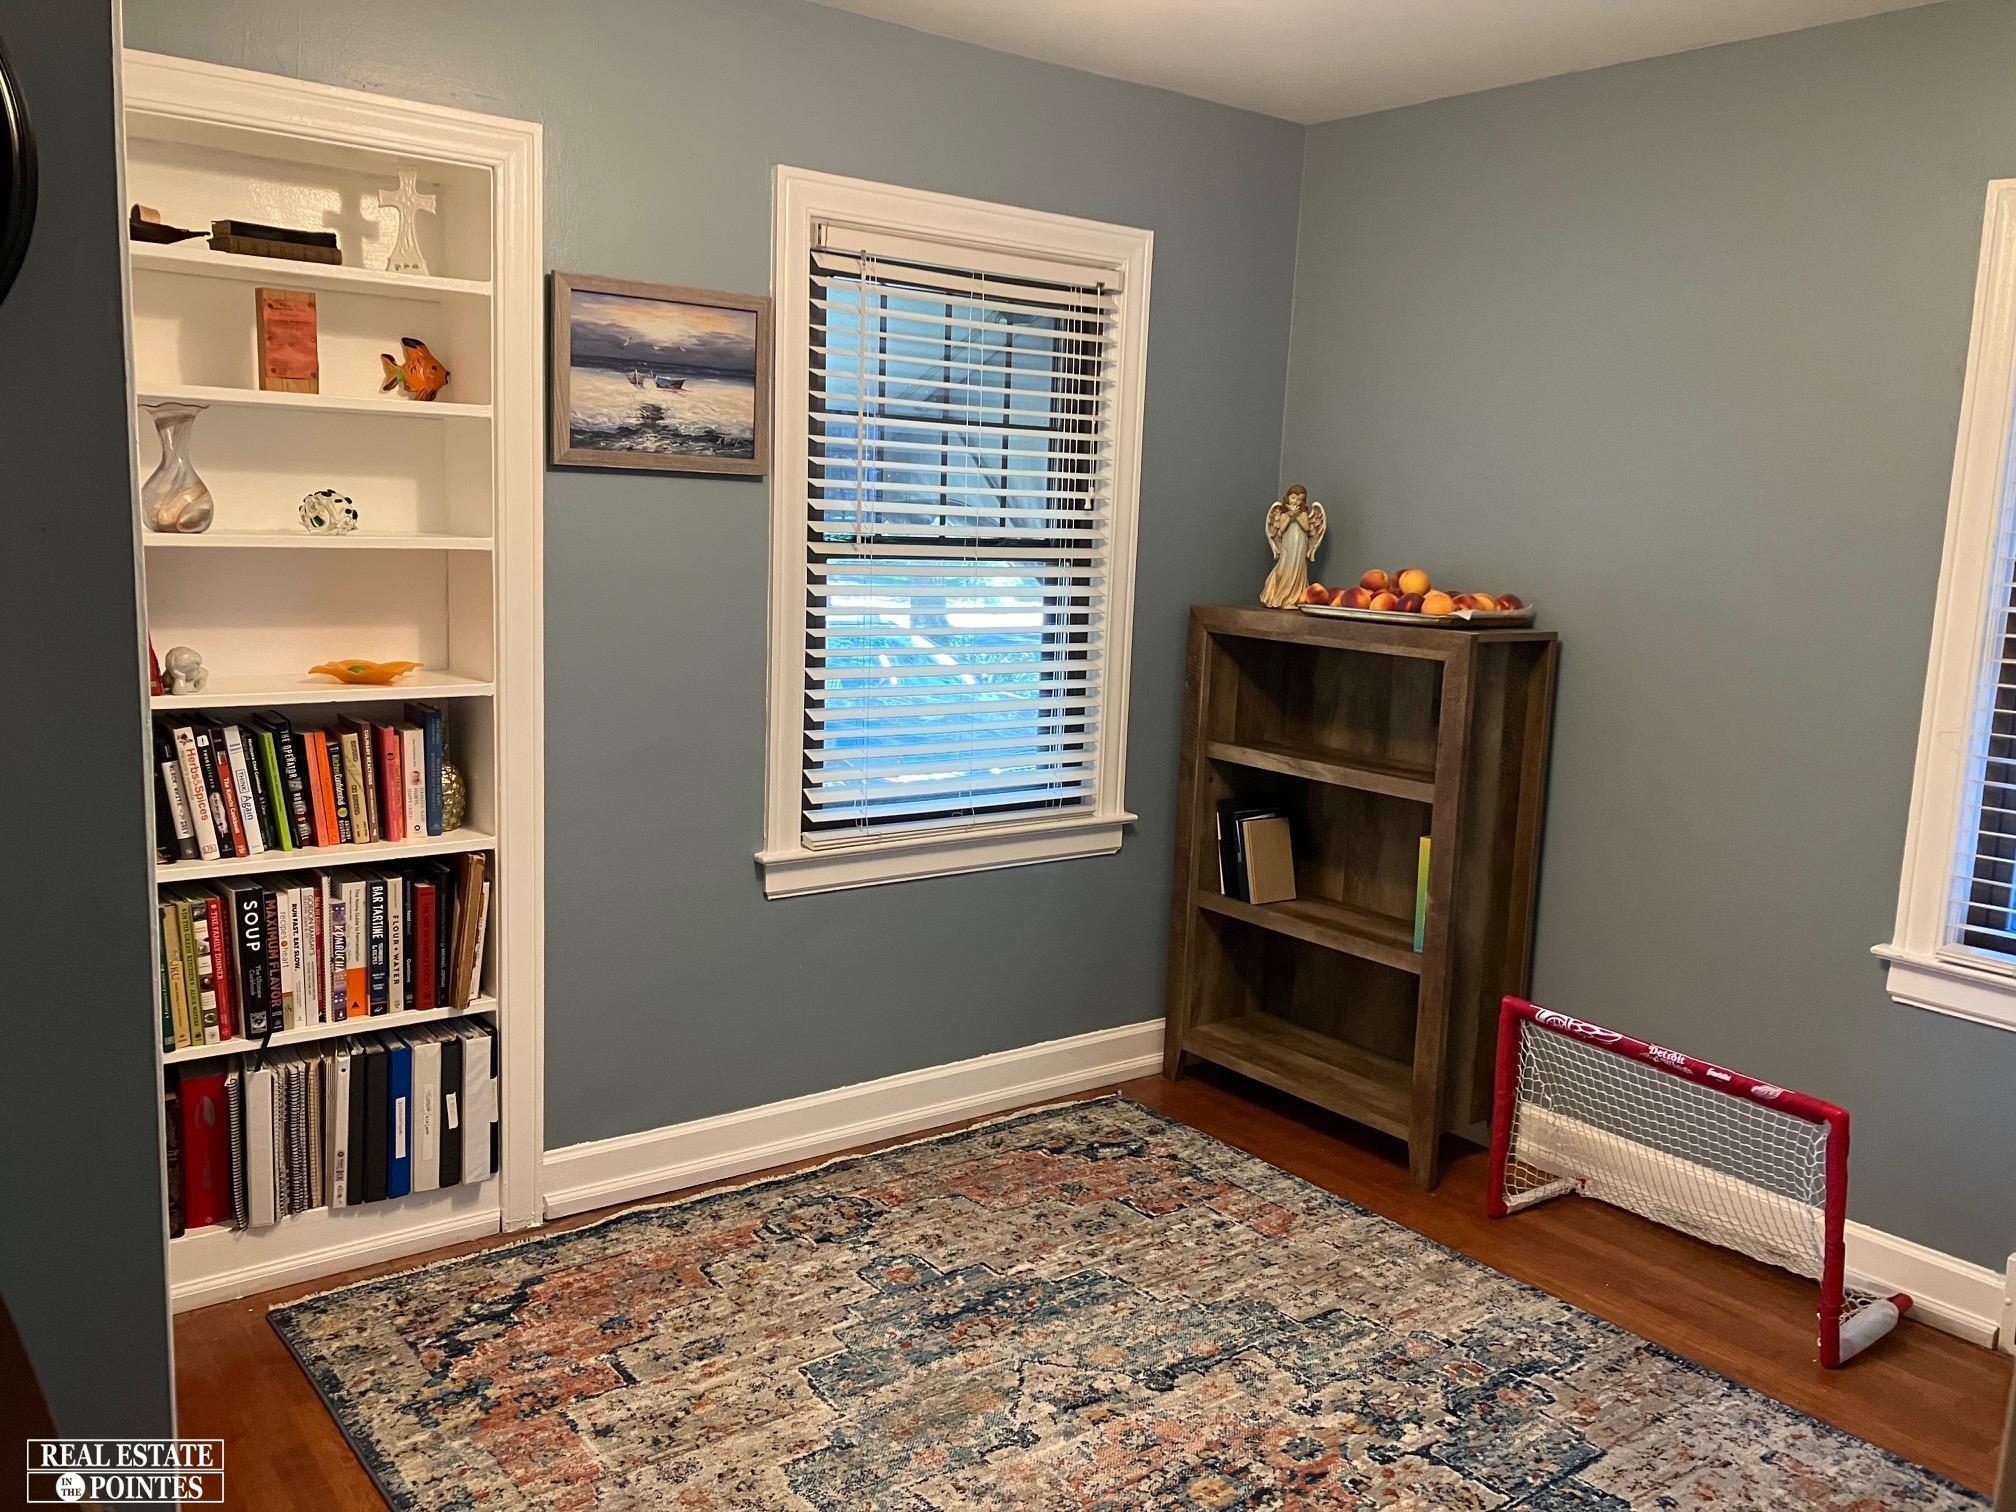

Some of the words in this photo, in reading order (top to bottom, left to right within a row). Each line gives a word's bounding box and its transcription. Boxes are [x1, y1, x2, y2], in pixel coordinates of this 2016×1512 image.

[281, 730, 291, 743] THE
[282, 744, 298, 779] OPERATOR
[331, 754, 341, 775] Kitchen
[366, 755, 374, 786] REACTIONS
[186, 748, 200, 780] Herbs
[195, 785, 209, 821] Spices
[237, 770, 249, 792] THINK
[334, 773, 346, 806] Confidential
[225, 788, 235, 808] Kimchi
[231, 807, 241, 834] Cookbook
[241, 795, 254, 820] Again
[293, 792, 306, 815] ROBERT
[371, 886, 384, 903] BAR
[243, 900, 261, 952] SOUP
[265, 899, 280, 961] MAXIMUM
[280, 911, 288, 940] recipes
[371, 905, 384, 940] TARTINE
[212, 927, 221, 953] FAMILY
[308, 925, 316, 957] RAMSAY'S
[332, 925, 346, 974] KOMBUCHA
[215, 953, 224, 980] DINNER
[254, 965, 262, 976] The
[281, 947, 289, 968] heart
[254, 977, 262, 999] Ultimate
[269, 961, 283, 1008] FLAVOR
[1648, 1044, 1686, 1065] Detroit
